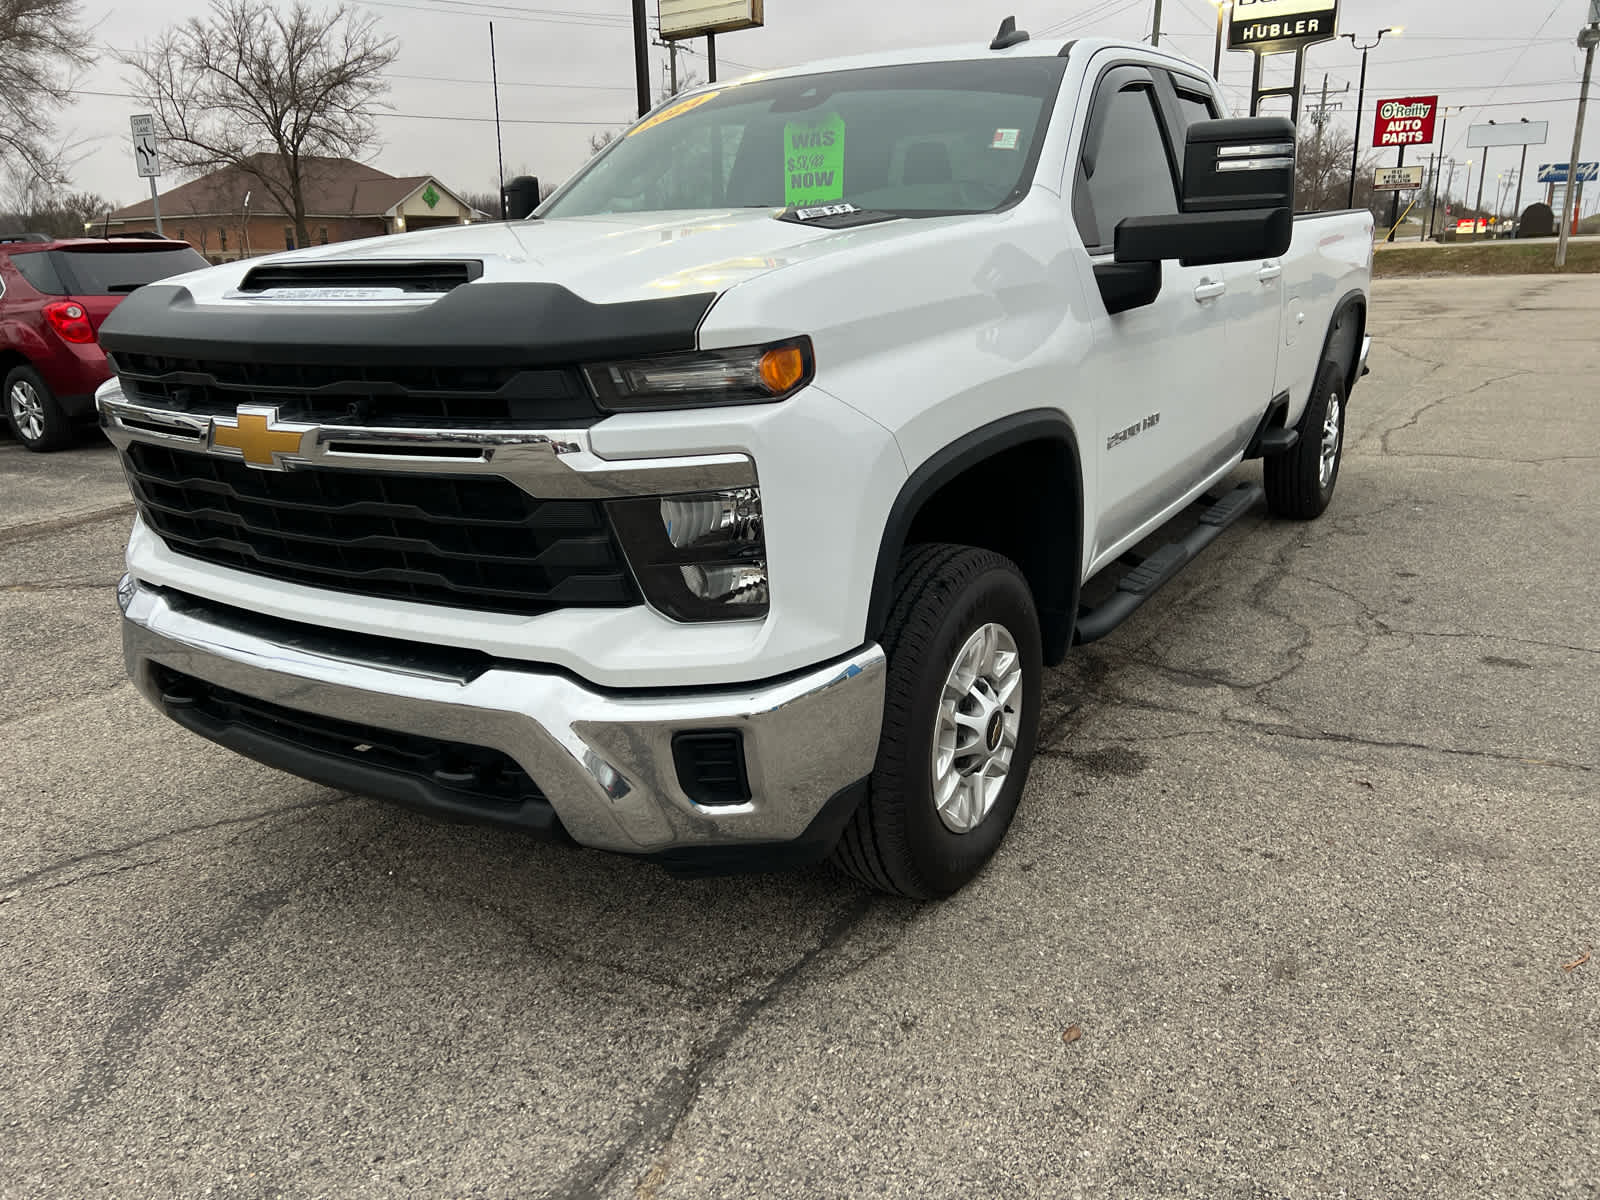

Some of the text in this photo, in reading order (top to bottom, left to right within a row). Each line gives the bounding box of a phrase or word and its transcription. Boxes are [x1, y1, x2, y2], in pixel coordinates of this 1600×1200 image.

[1243, 19, 1319, 40] HUBLER
[1381, 102, 1431, 119] O'Reilly
[1386, 119, 1422, 132] AUTO
[791, 129, 835, 149] WAS
[1382, 131, 1424, 144] PARTS
[791, 170, 834, 189] NOW
